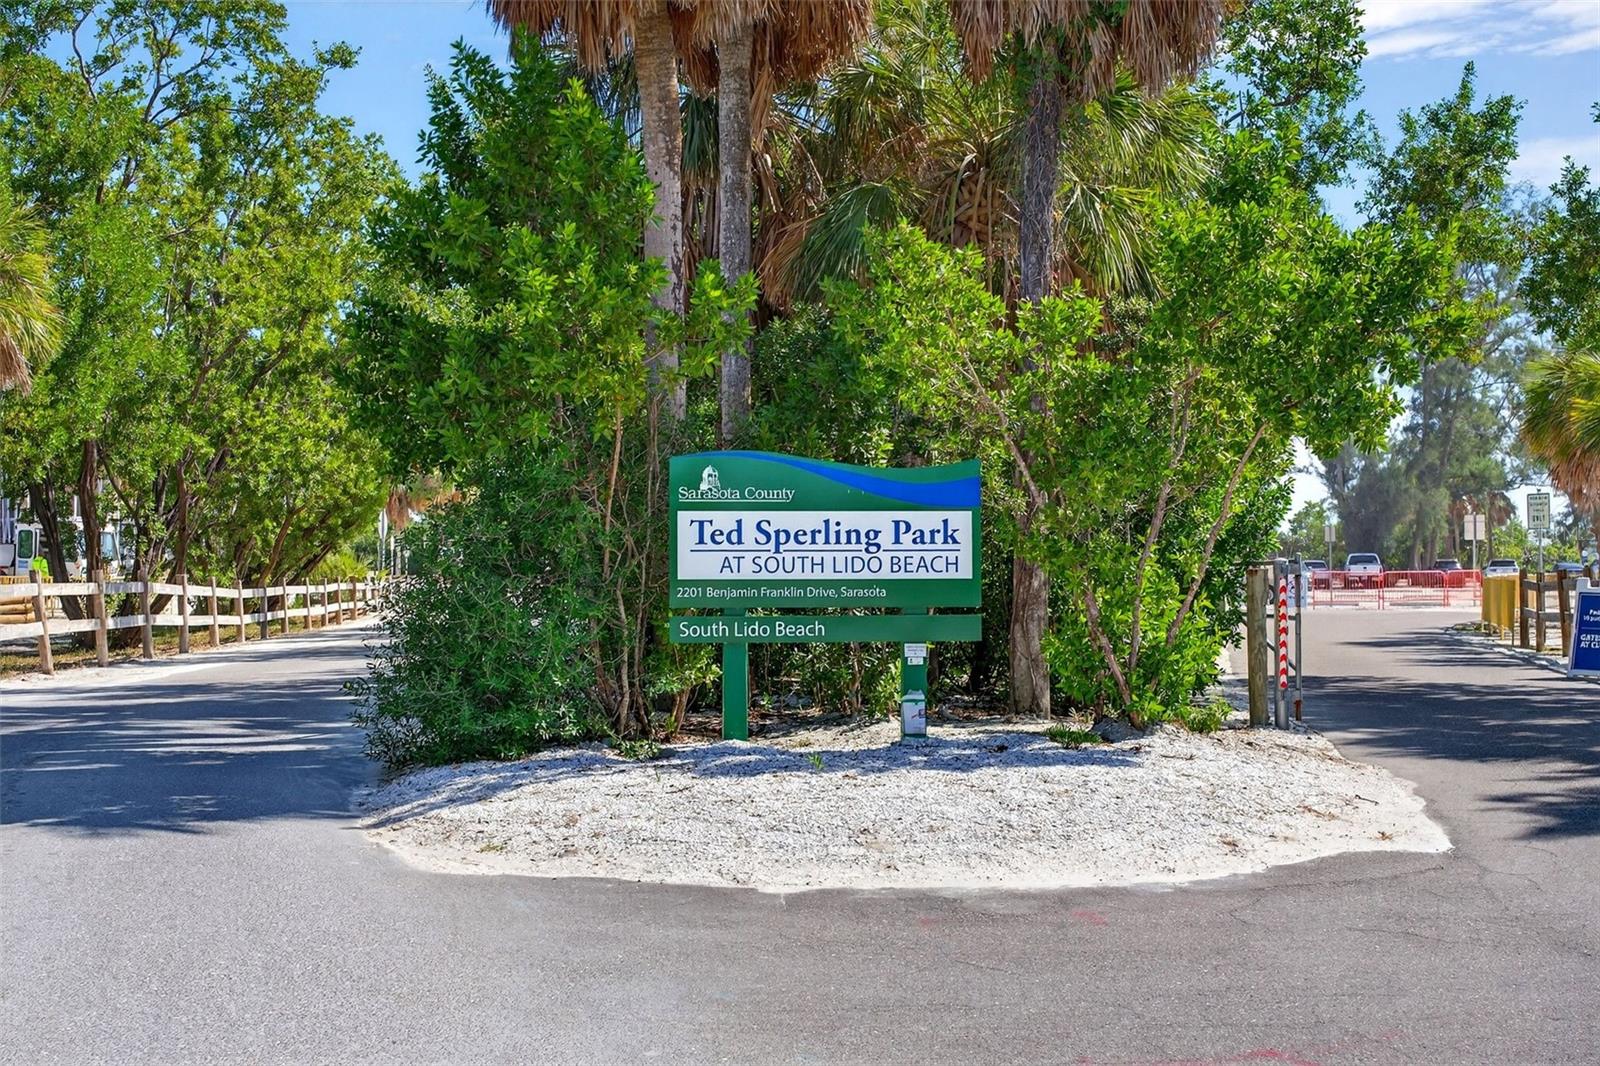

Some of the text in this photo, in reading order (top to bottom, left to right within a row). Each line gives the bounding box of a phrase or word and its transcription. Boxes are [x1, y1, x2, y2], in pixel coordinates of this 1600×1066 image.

[678, 486, 795, 502] Sarasota County
[689, 518, 961, 554] Ted Sperling Park
[719, 555, 959, 574] AT SOUTH LIDO BEACH
[676, 586, 887, 600] 2201 Benjamin Franklin Drive, Sarasota
[679, 620, 825, 637] South Lido Beach
